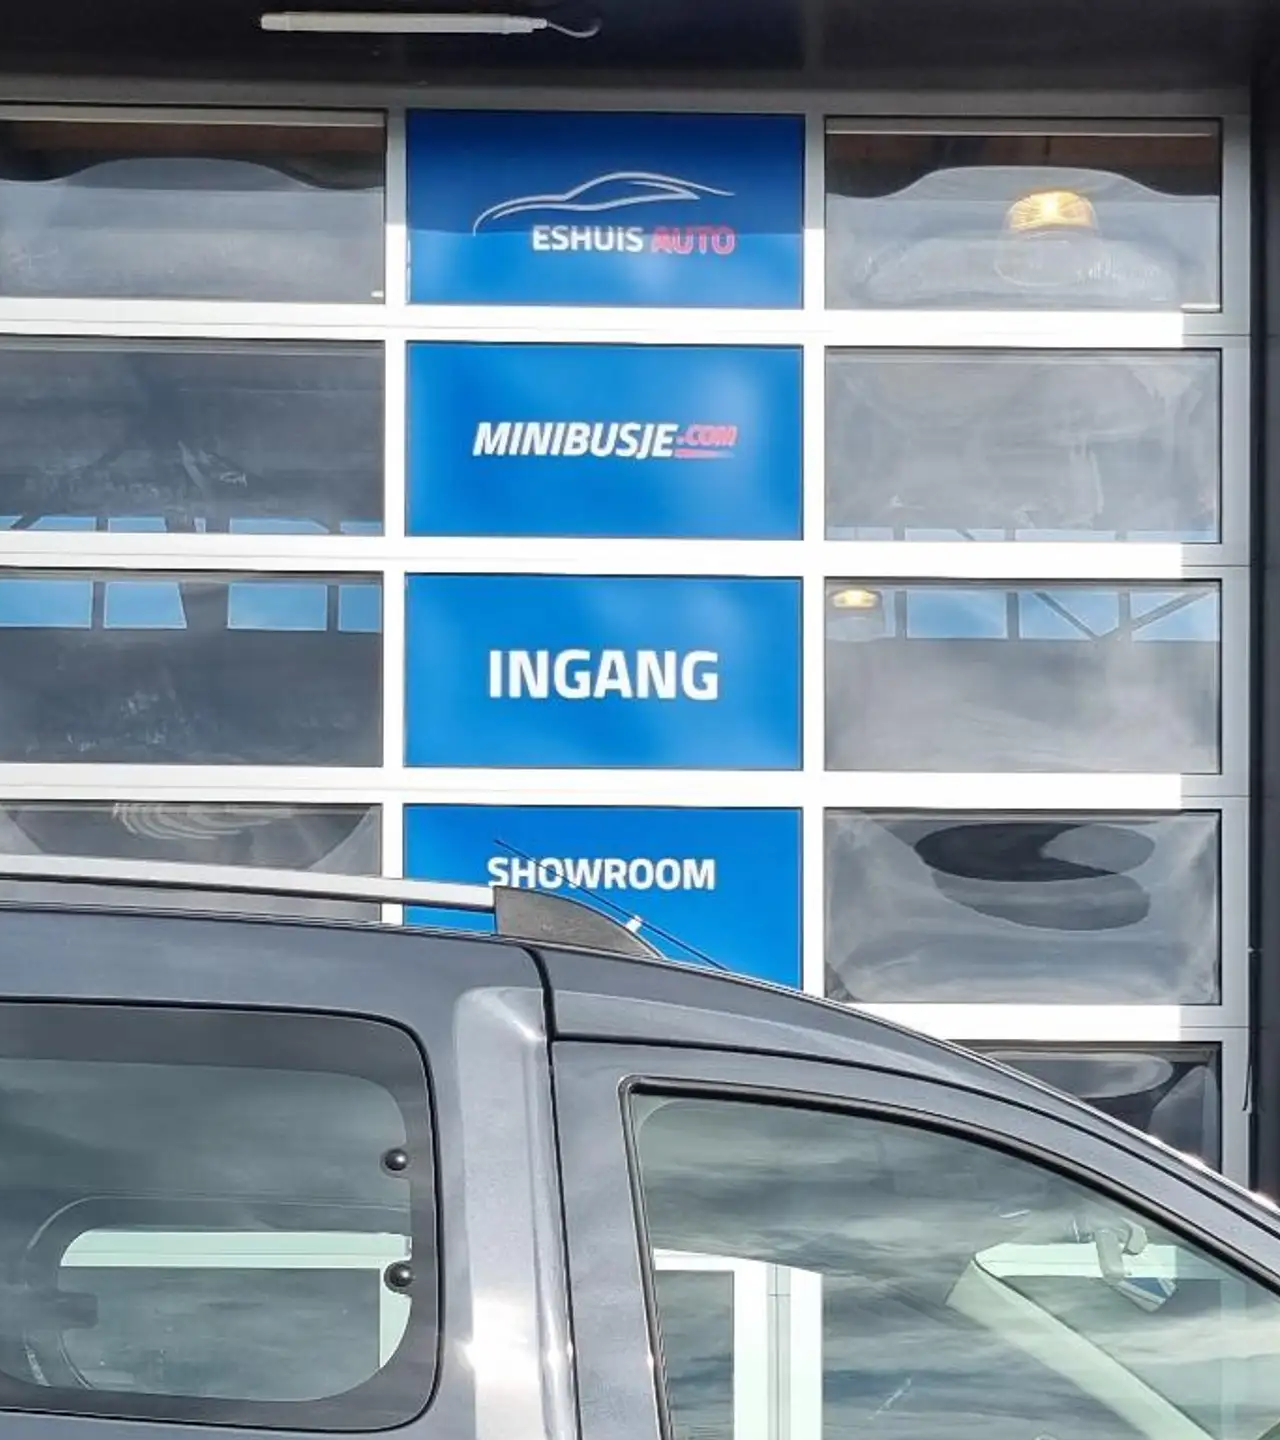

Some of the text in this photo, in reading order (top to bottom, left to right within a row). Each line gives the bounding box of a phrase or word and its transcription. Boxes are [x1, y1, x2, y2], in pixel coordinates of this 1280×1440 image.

[532, 224, 736, 255] ESHUIS AUTO
[488, 648, 719, 701] INGANG
[486, 856, 716, 891] SHOWROOM
